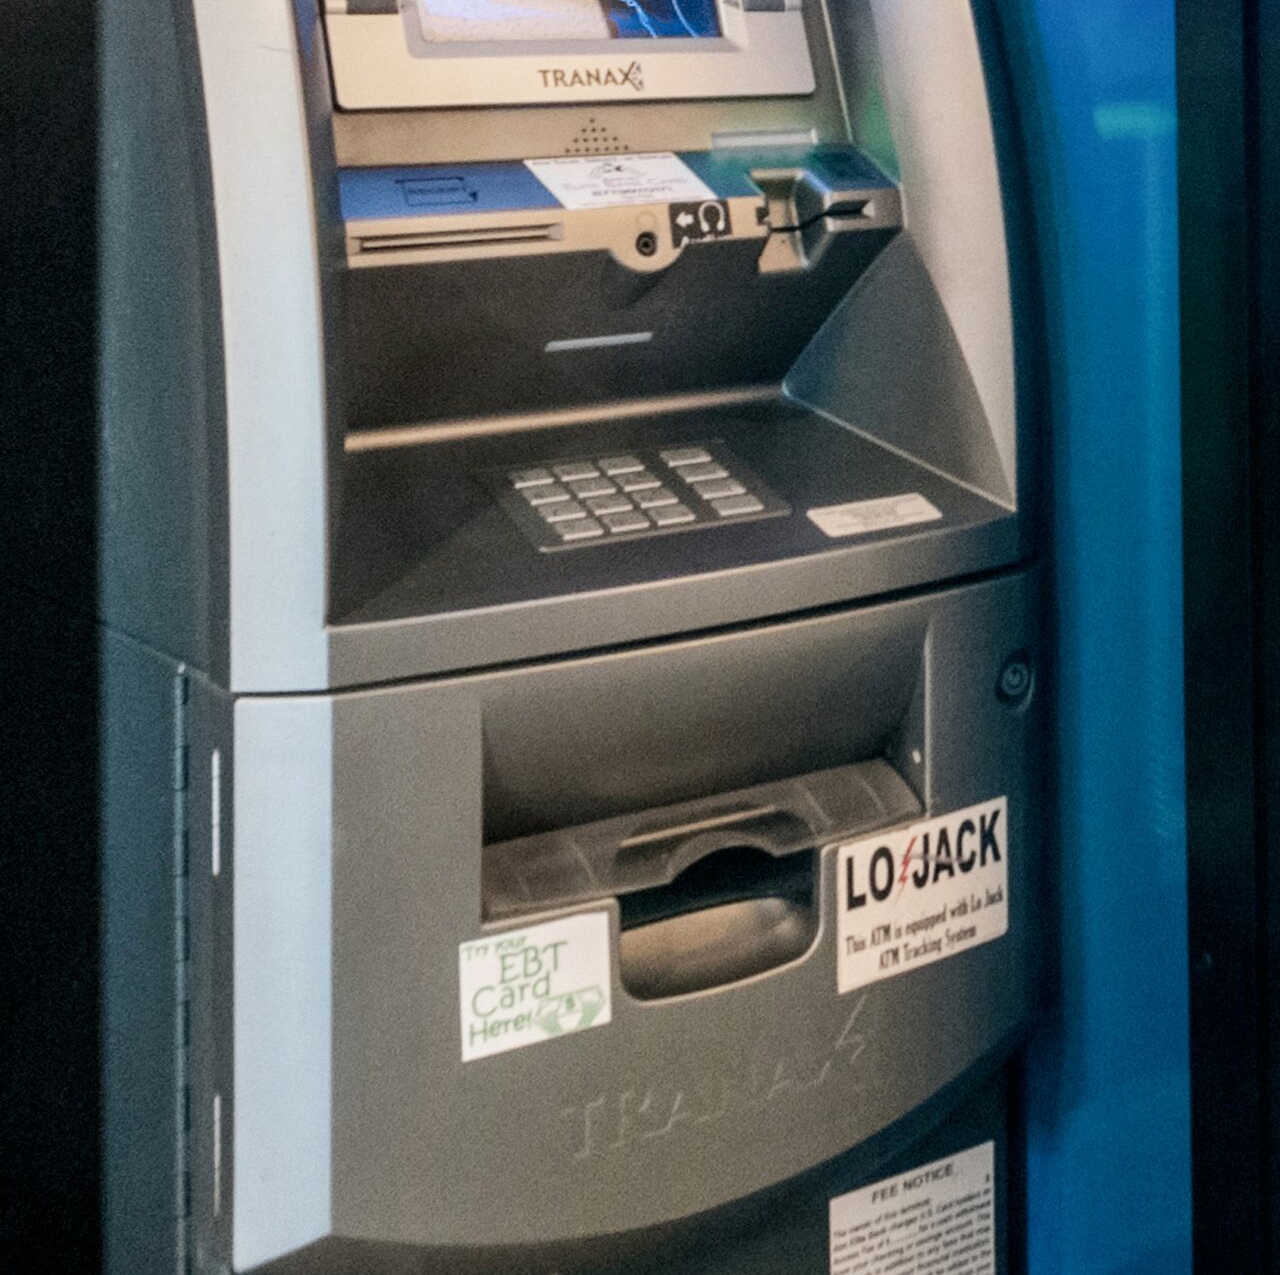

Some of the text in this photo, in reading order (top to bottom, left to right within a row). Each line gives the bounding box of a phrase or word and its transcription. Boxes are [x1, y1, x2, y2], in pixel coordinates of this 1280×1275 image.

[537, 61, 641, 91] TRANAX
[846, 935, 866, 956] This
[870, 924, 892, 947] ATM
[949, 898, 969, 919] with
[878, 924, 977, 971] ATM Tracking System
[499, 939, 569, 985] EBT
[471, 970, 552, 1018] Card
[870, 1162, 956, 1204] FEE NOTICE
